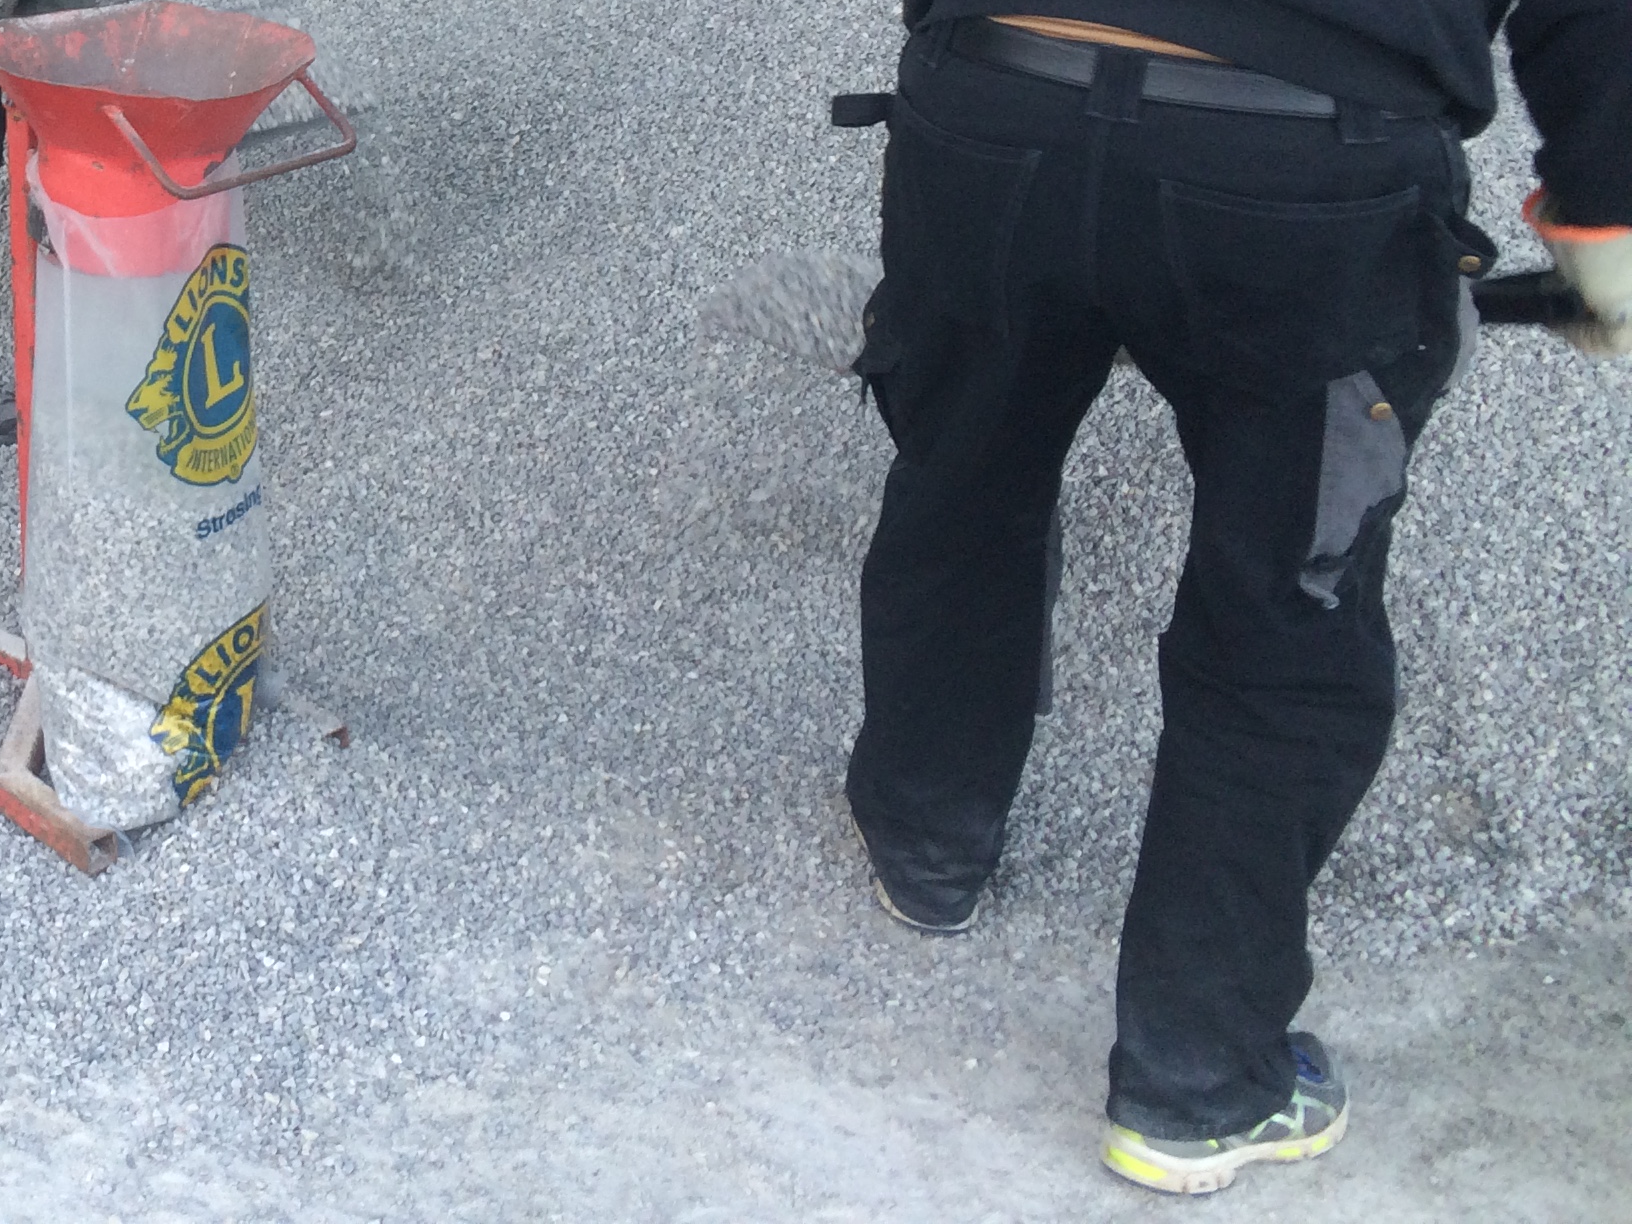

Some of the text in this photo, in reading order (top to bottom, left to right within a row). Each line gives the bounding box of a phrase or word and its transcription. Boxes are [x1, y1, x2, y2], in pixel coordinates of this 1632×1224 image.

[174, 254, 247, 333] LIONS
[200, 322, 245, 410] L
[194, 612, 265, 687] LIO
